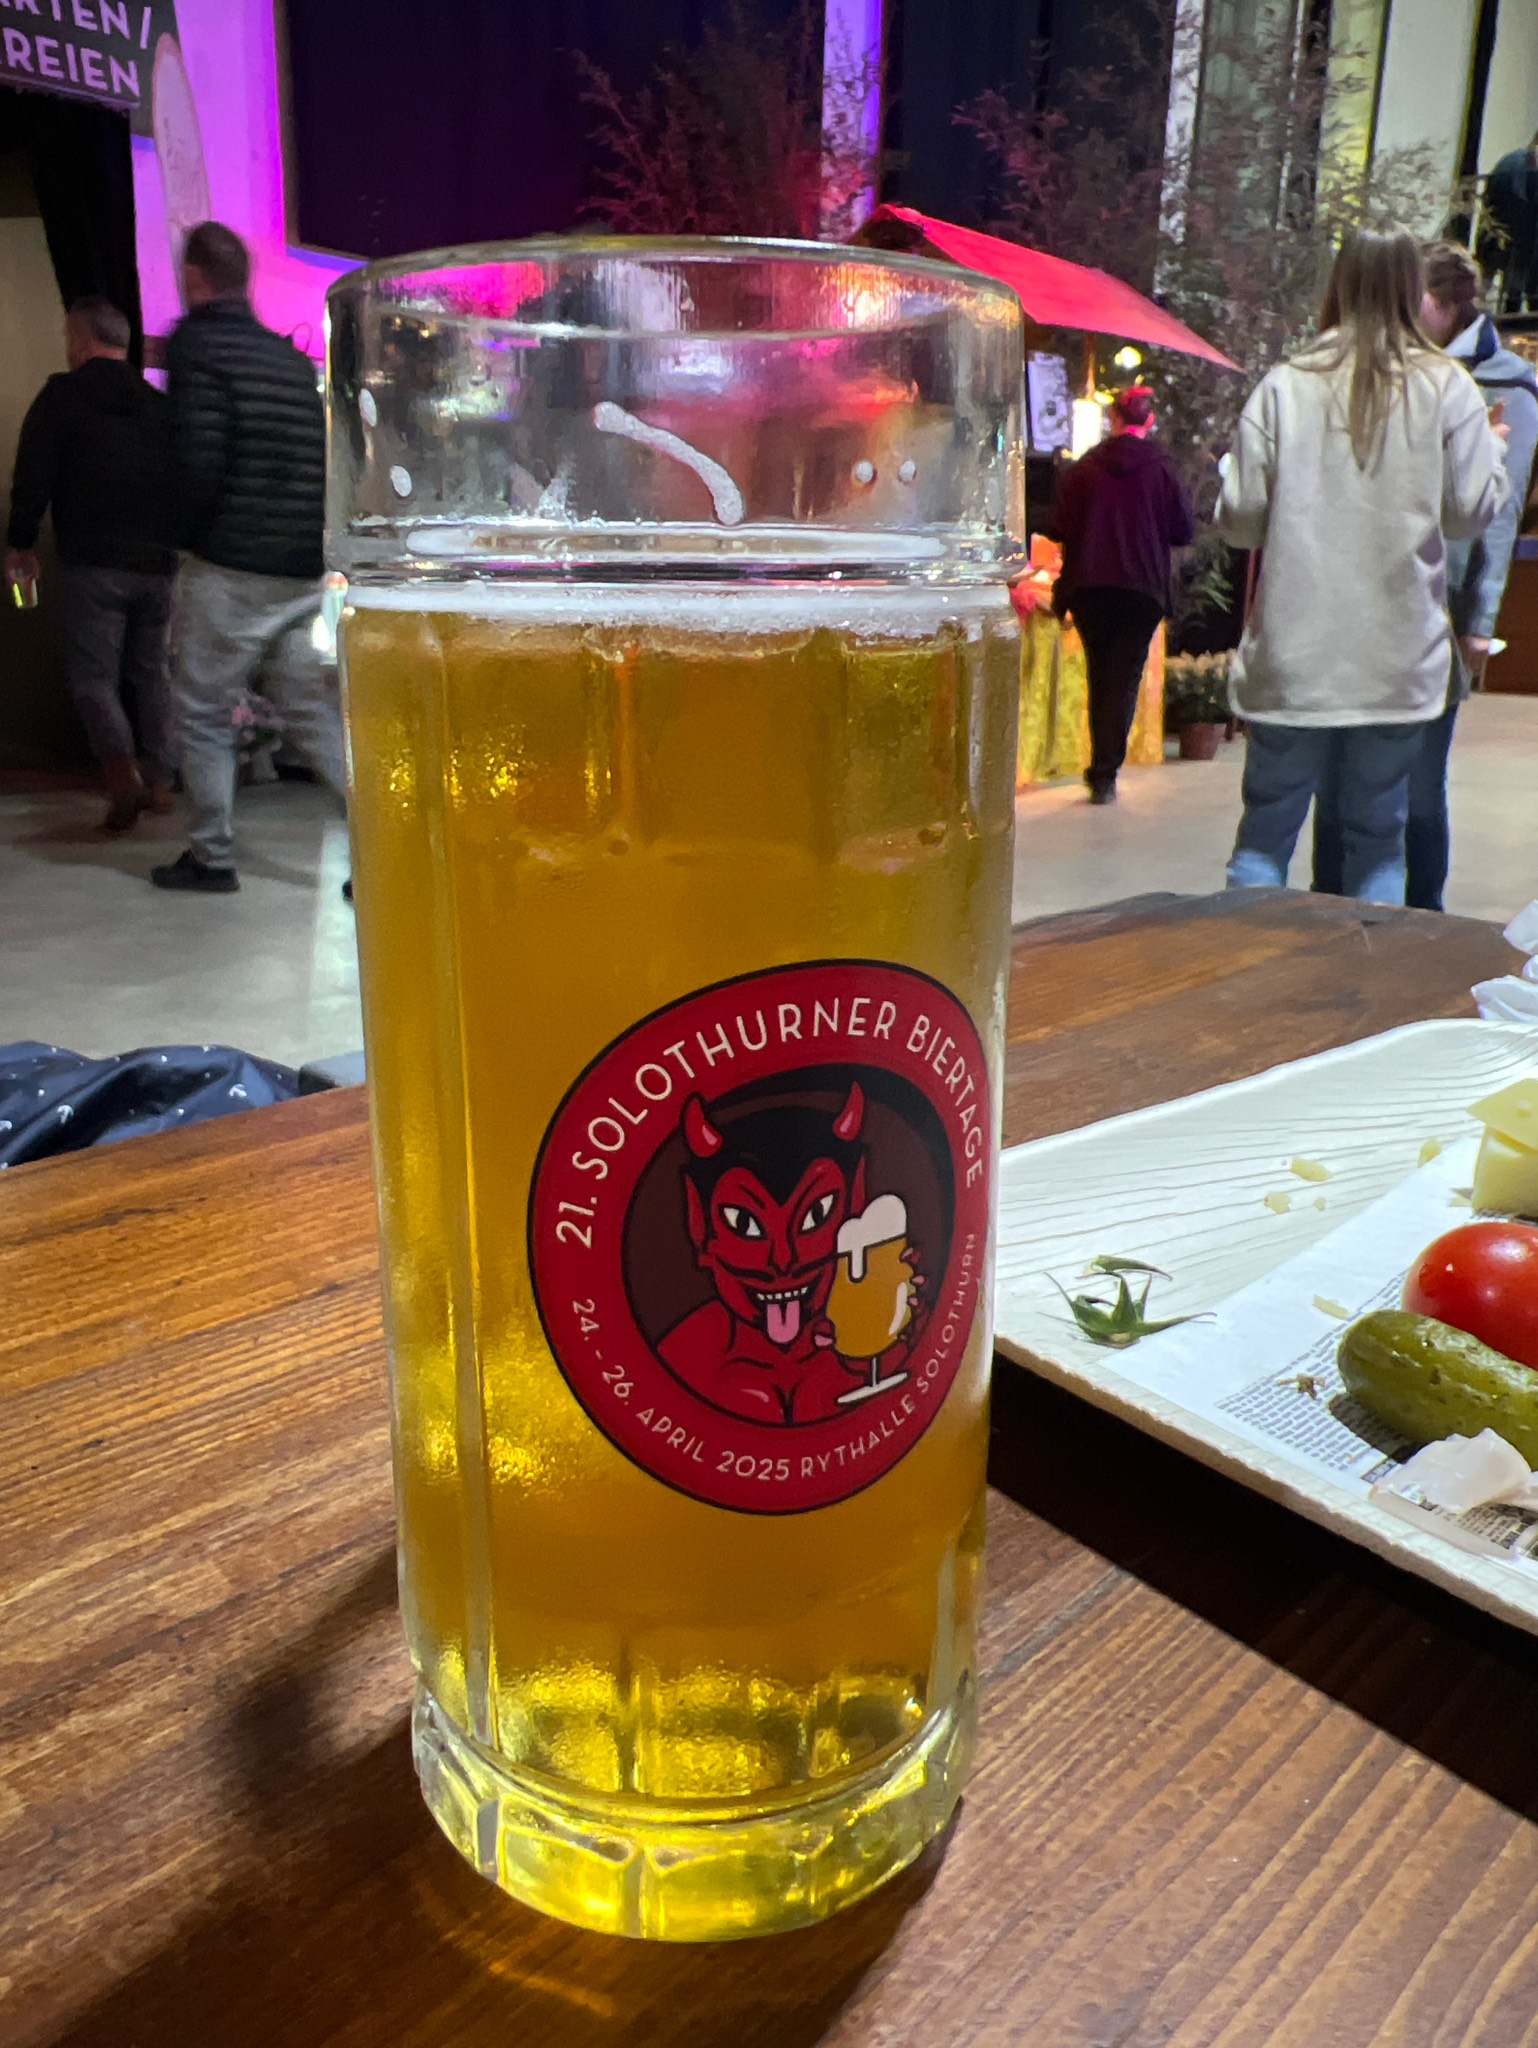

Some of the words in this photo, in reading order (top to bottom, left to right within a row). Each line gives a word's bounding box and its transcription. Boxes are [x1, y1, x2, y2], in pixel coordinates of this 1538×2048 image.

[0, 0, 152, 49] TEN/
[0, 27, 140, 98] REIEN
[572, 997, 898, 1181] SOLOTHURNER
[906, 1014, 983, 1188] BIERTAGE
[556, 1197, 597, 1249] 21.
[572, 1298, 600, 1341] 24.
[602, 1364, 634, 1406] 26.
[636, 1407, 705, 1463] APRIL
[716, 1450, 790, 1481] 2025
[801, 1394, 916, 1477] RYTHALLE
[916, 1233, 978, 1393] SOLOTHURN
